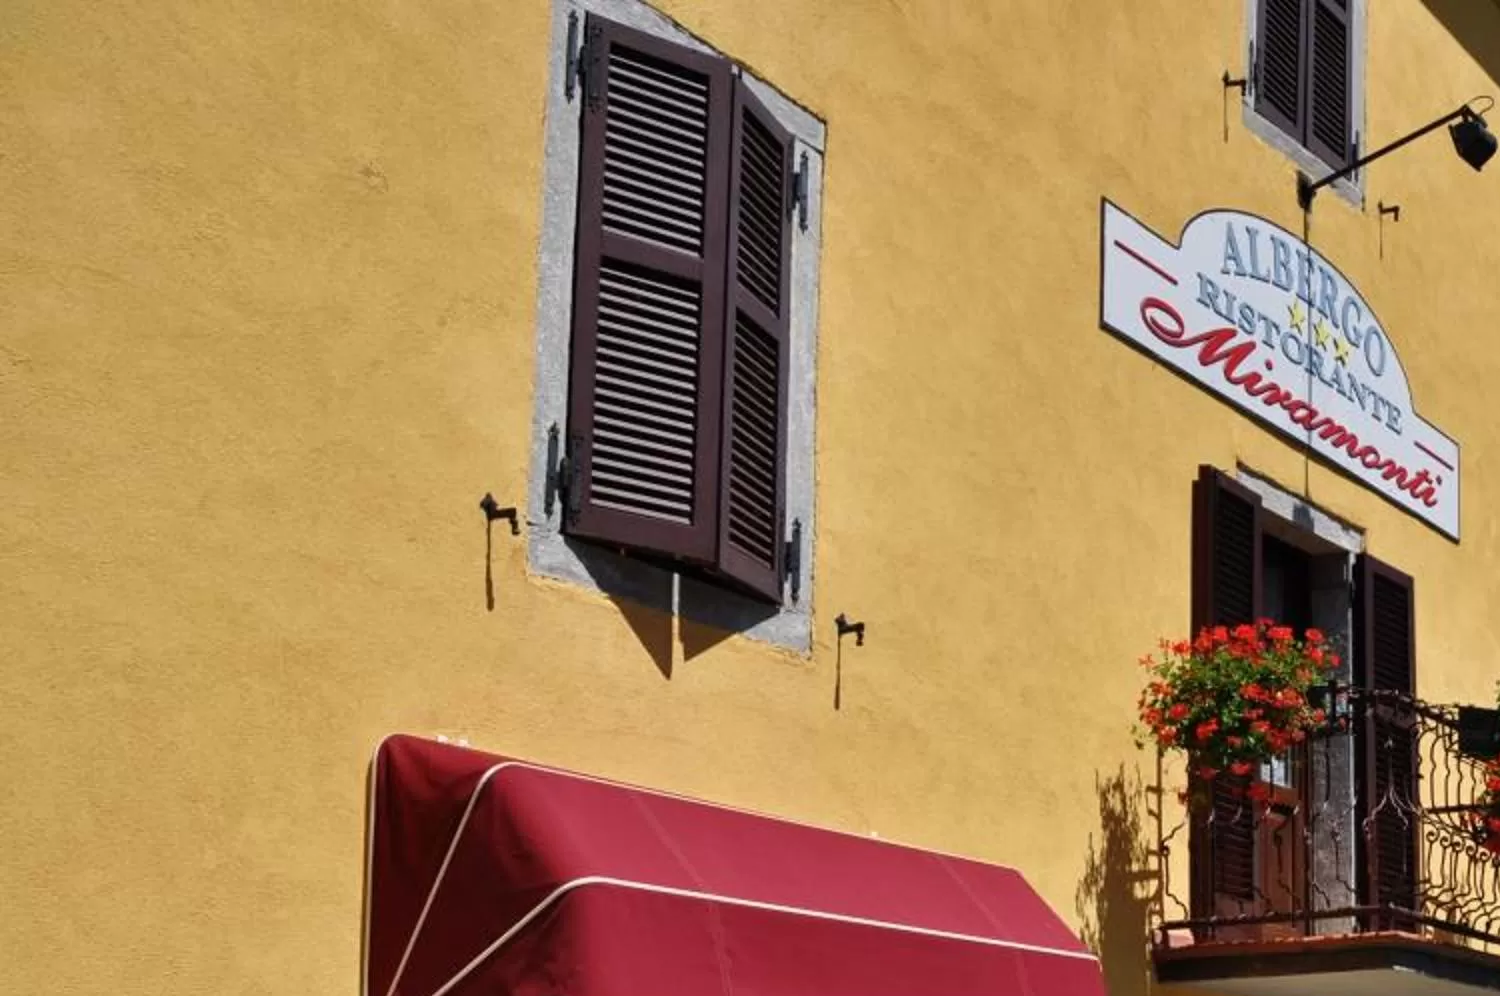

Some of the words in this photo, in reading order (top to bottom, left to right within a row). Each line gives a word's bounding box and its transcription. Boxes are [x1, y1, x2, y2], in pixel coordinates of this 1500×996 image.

[1196, 271, 1403, 435] RISTORANTE
[1220, 220, 1386, 378] ALBERGO
[1140, 296, 1439, 507] Miramonti
